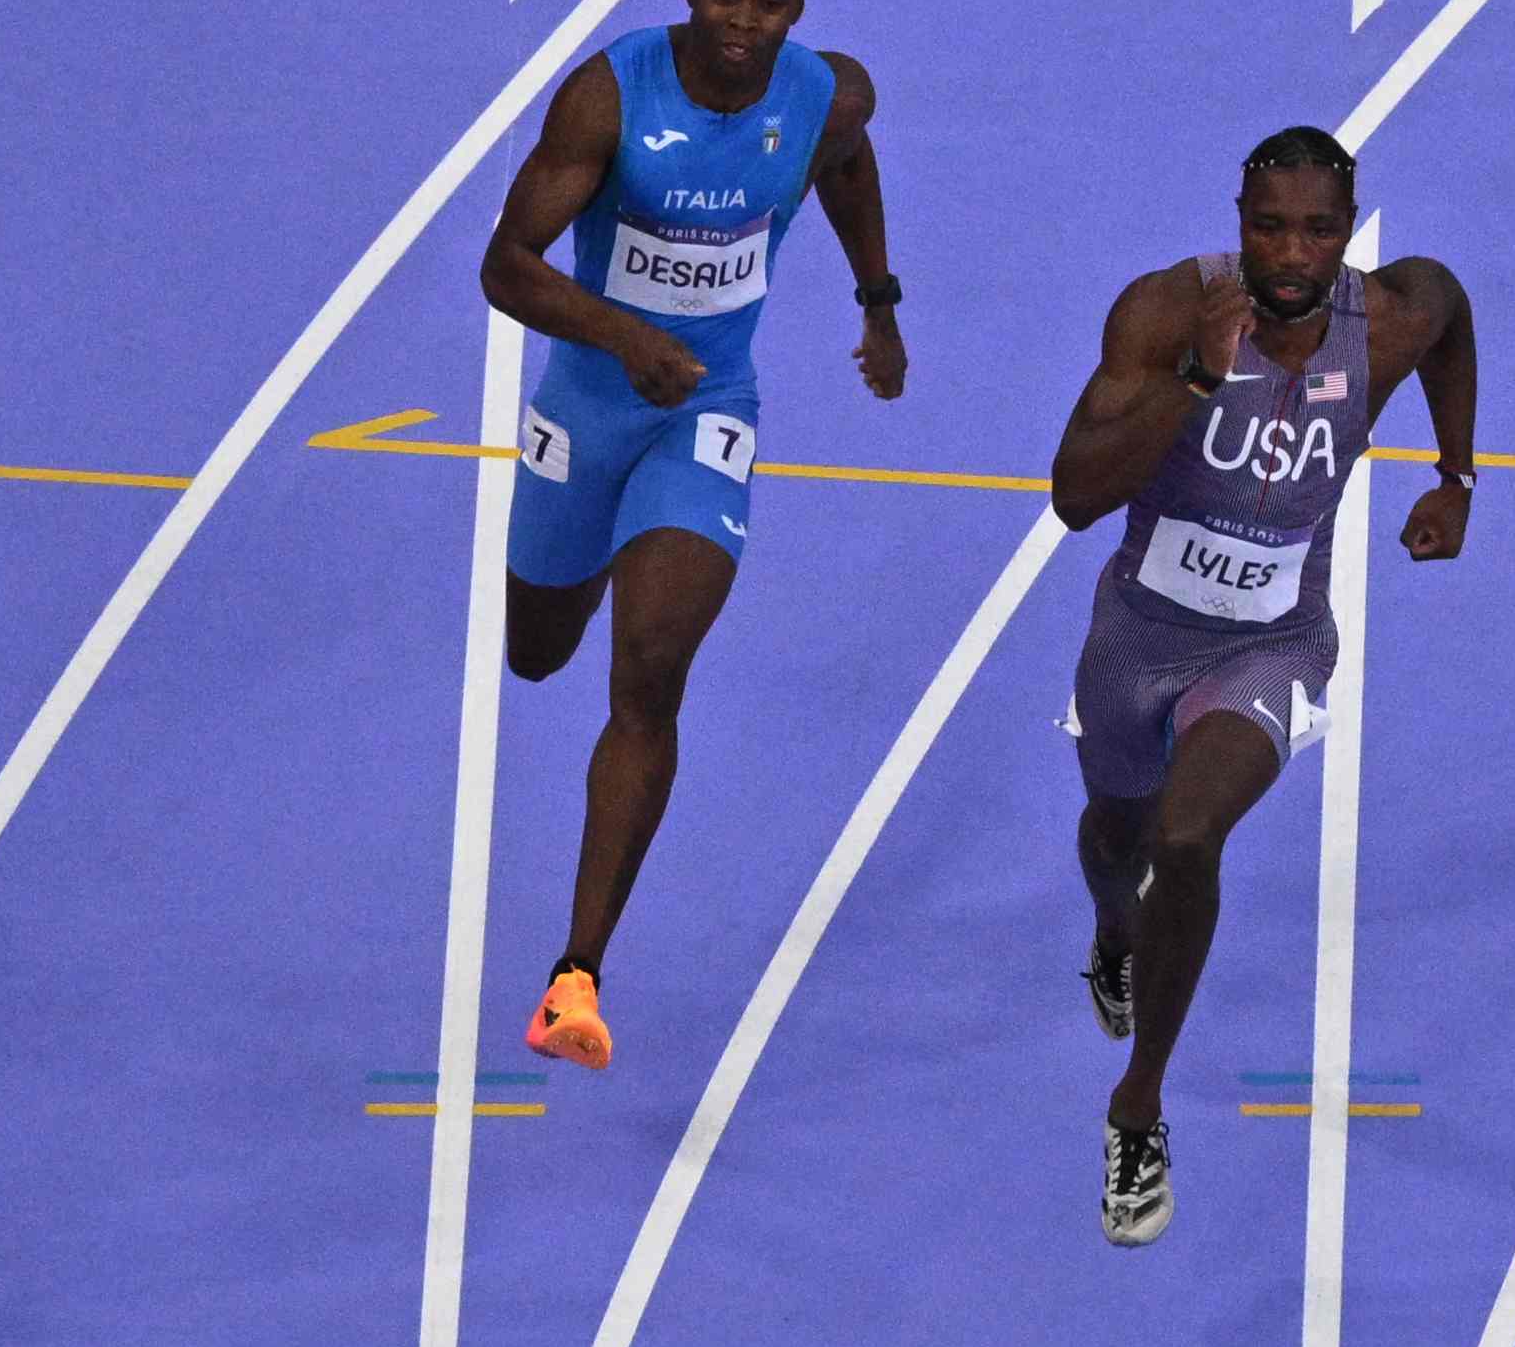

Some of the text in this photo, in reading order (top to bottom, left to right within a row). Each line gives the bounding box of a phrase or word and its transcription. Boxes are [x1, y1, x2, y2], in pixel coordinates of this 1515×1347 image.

[663, 188, 747, 210] ITALIA
[657, 225, 698, 239] PARIS
[625, 244, 756, 289] DESALU
[533, 424, 553, 463] 7
[717, 426, 741, 462] 7
[1202, 405, 1335, 482] USA
[1205, 514, 1285, 543] PARIS 2024
[1179, 539, 1278, 591] LYLES
